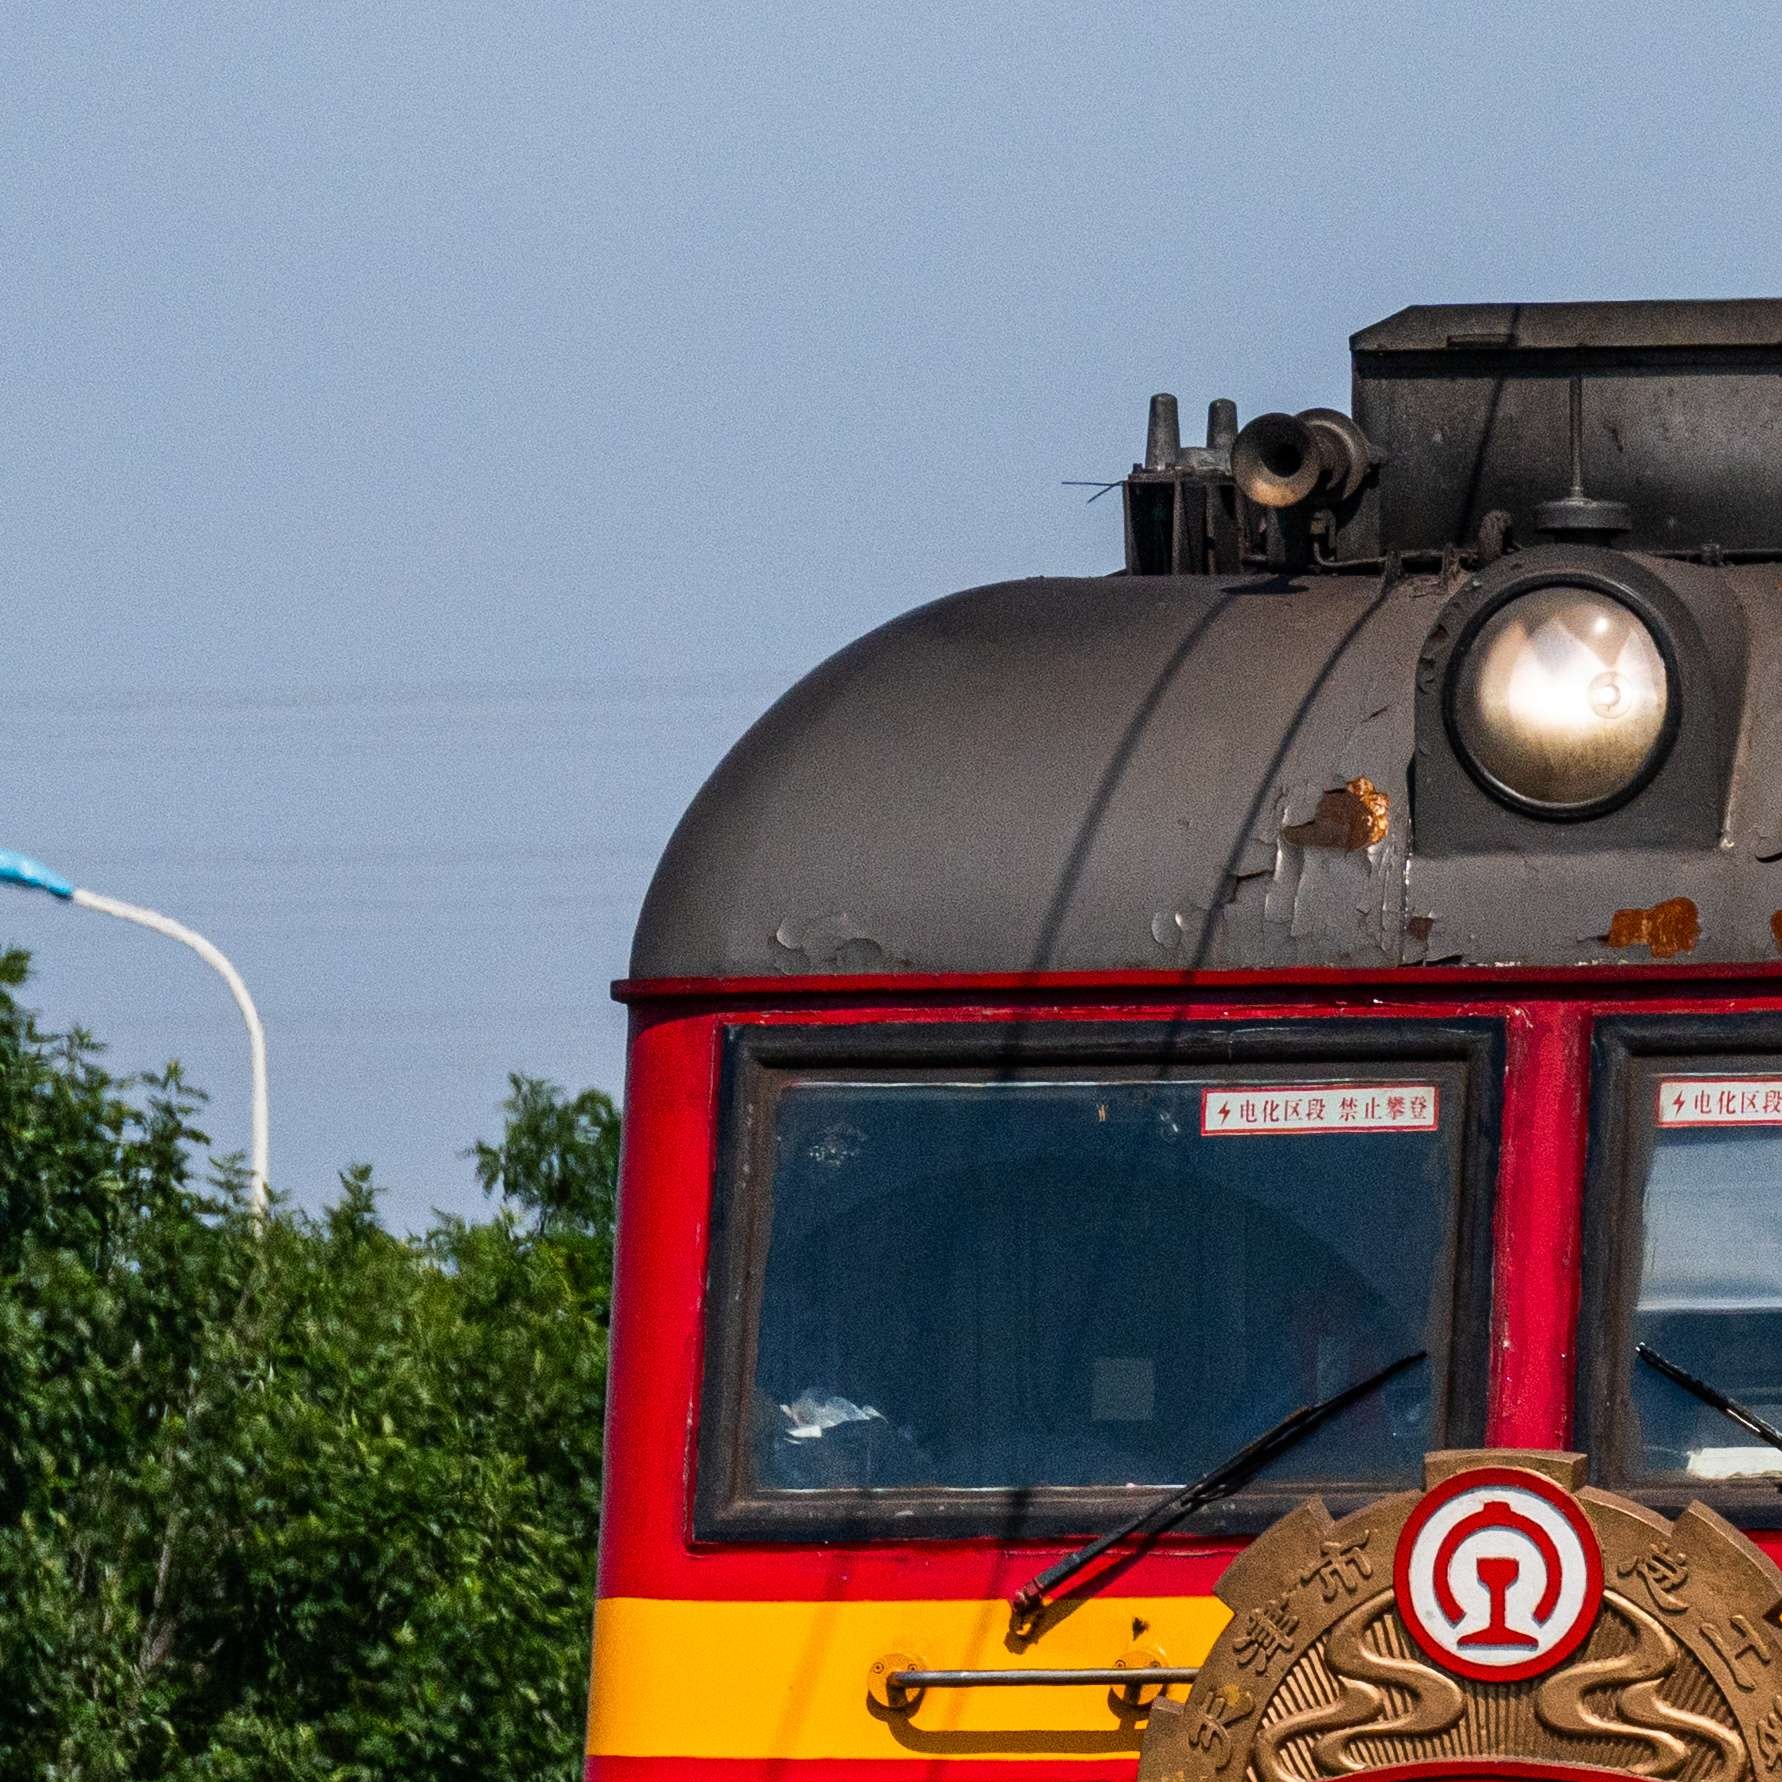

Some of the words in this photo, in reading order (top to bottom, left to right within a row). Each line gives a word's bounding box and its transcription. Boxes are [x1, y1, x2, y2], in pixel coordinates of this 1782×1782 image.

[1239, 1097, 1327, 1124] 电化区段
[1338, 1095, 1428, 1123] 禁止攀登
[1693, 1089, 1782, 1115] 电化区段
